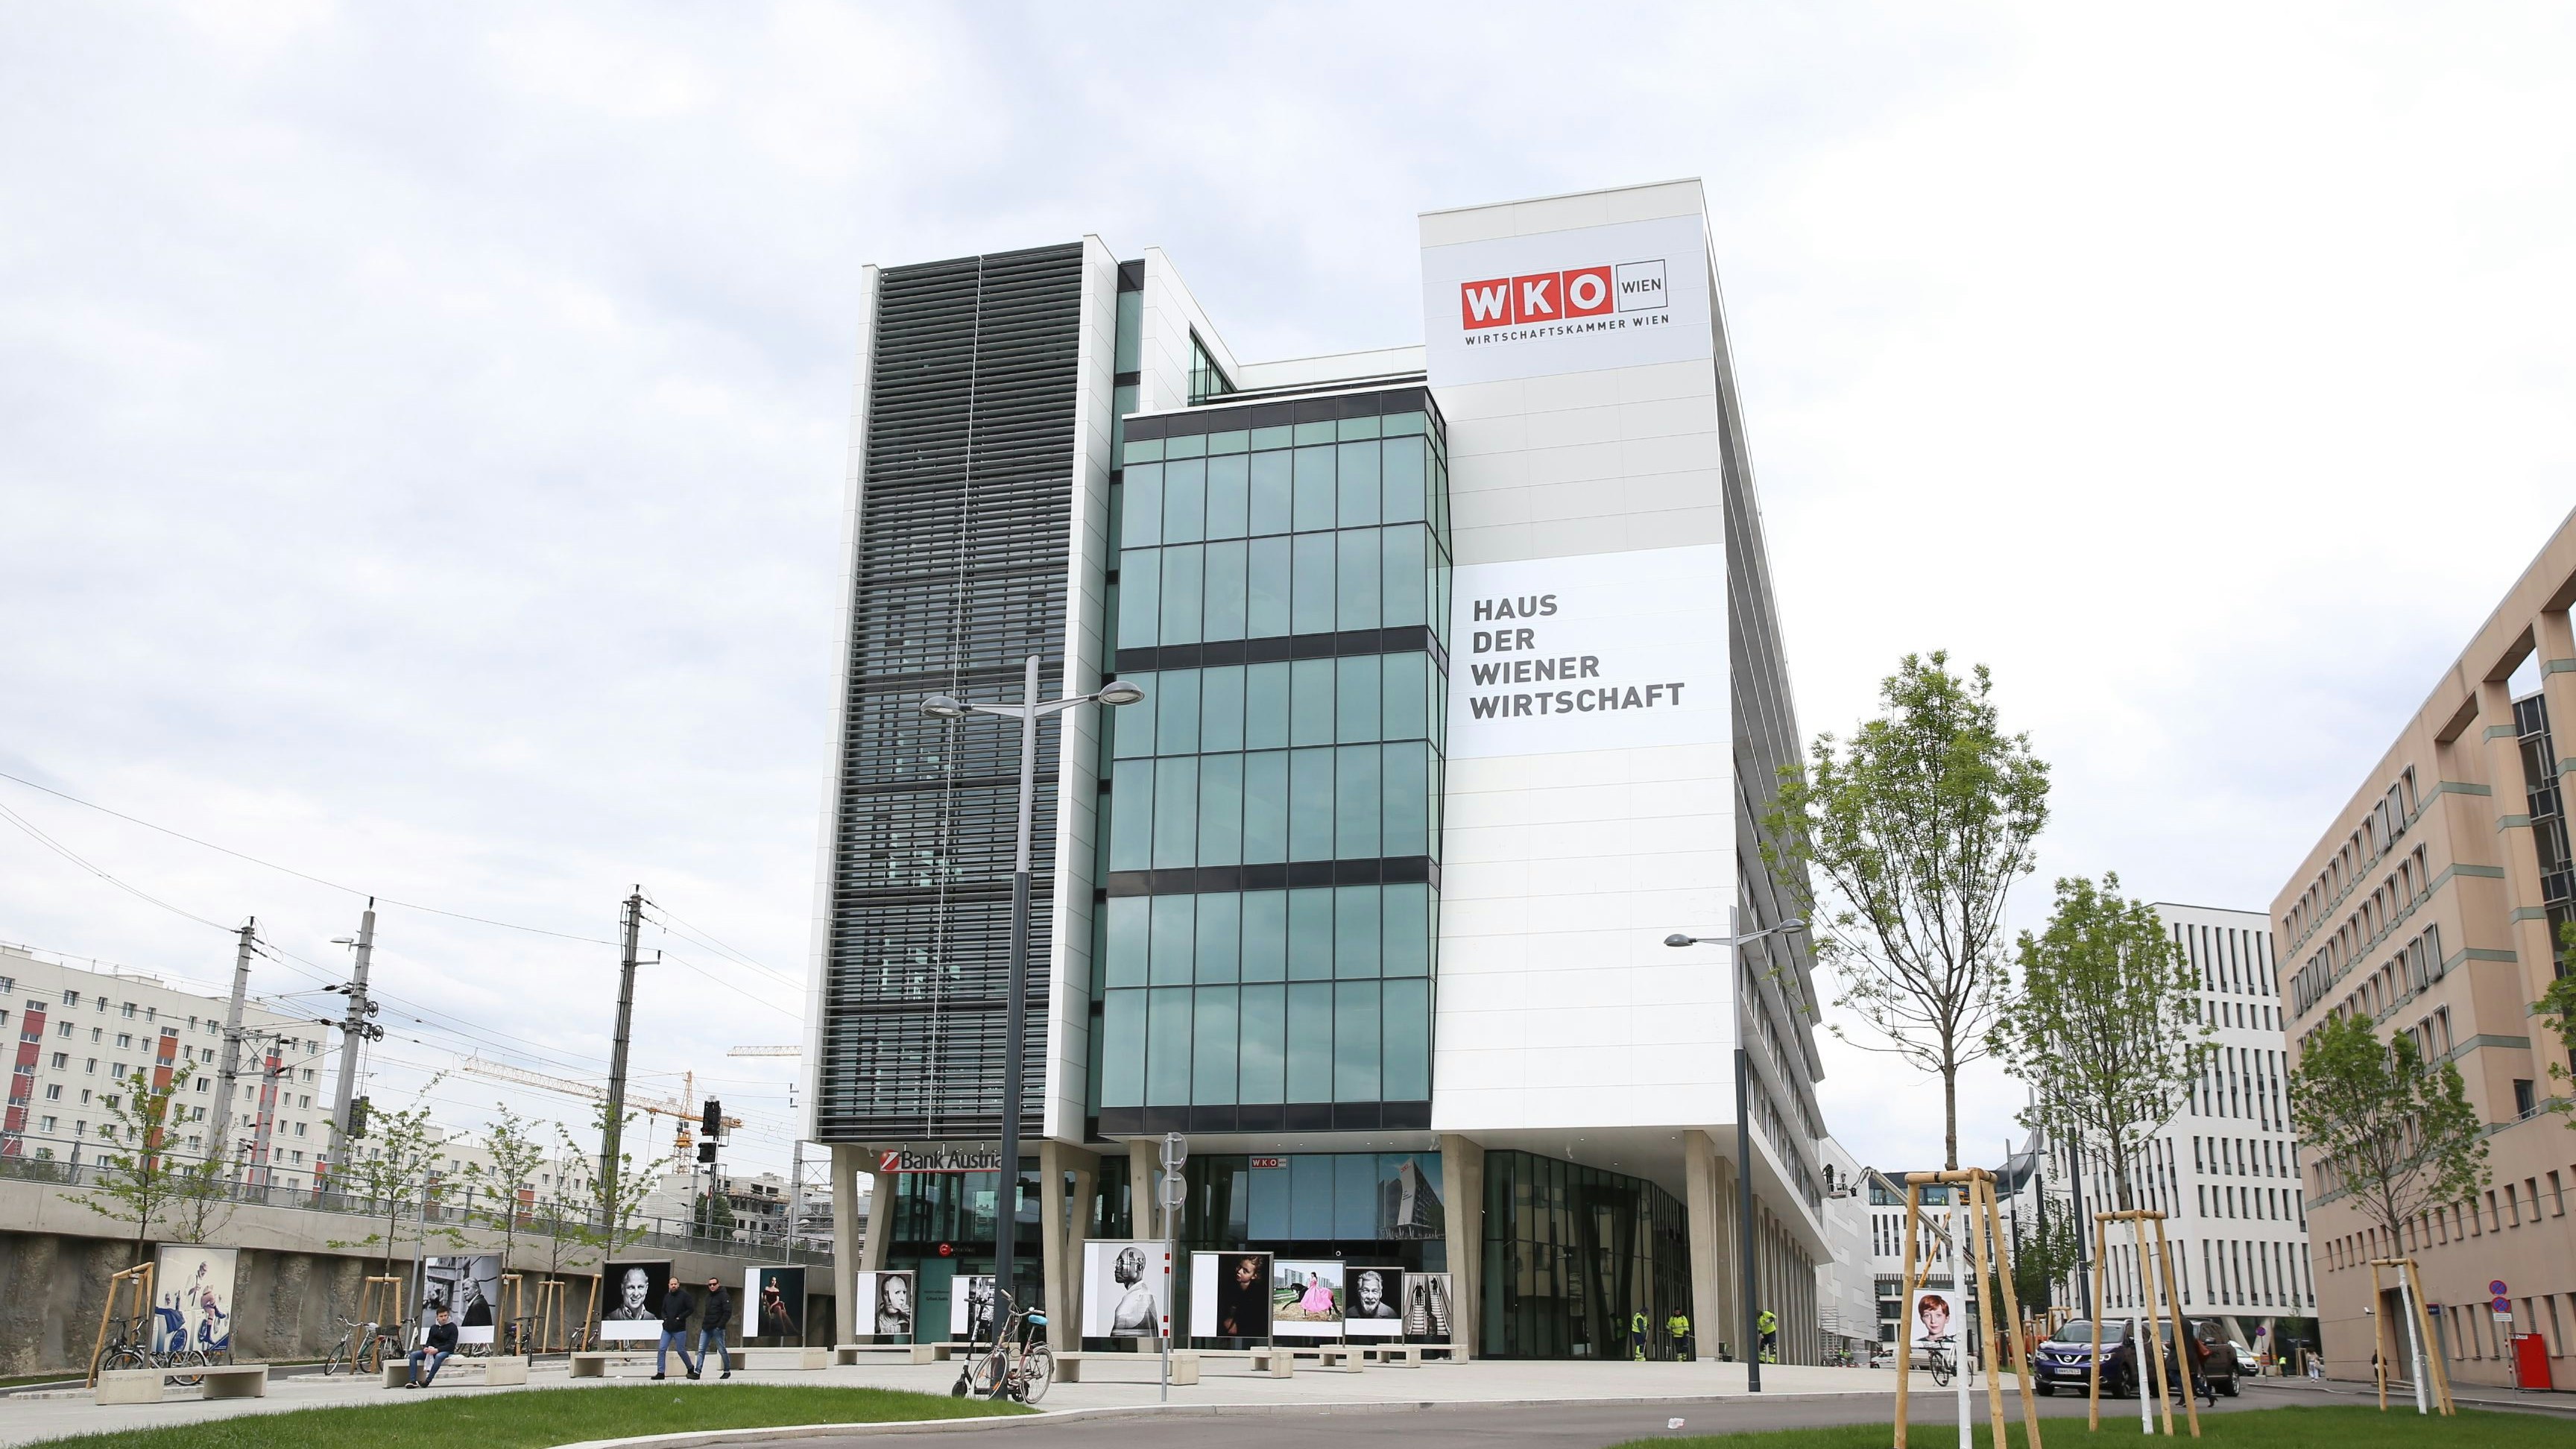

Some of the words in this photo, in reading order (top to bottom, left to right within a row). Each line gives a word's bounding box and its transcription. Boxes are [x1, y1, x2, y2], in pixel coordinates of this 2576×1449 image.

[1465, 274, 1606, 321] WKO
[1621, 278, 1661, 294] WIEN
[1465, 320, 1626, 345] WIRTSCHAFTSKAMMER
[1633, 315, 1670, 326] WIEN
[1474, 594, 1558, 622] HAUS
[1473, 628, 1535, 653] DER
[1471, 655, 1600, 686] WIENER
[1470, 683, 1685, 719] WIRTSCHAFT
[901, 1150, 944, 1169] Bank
